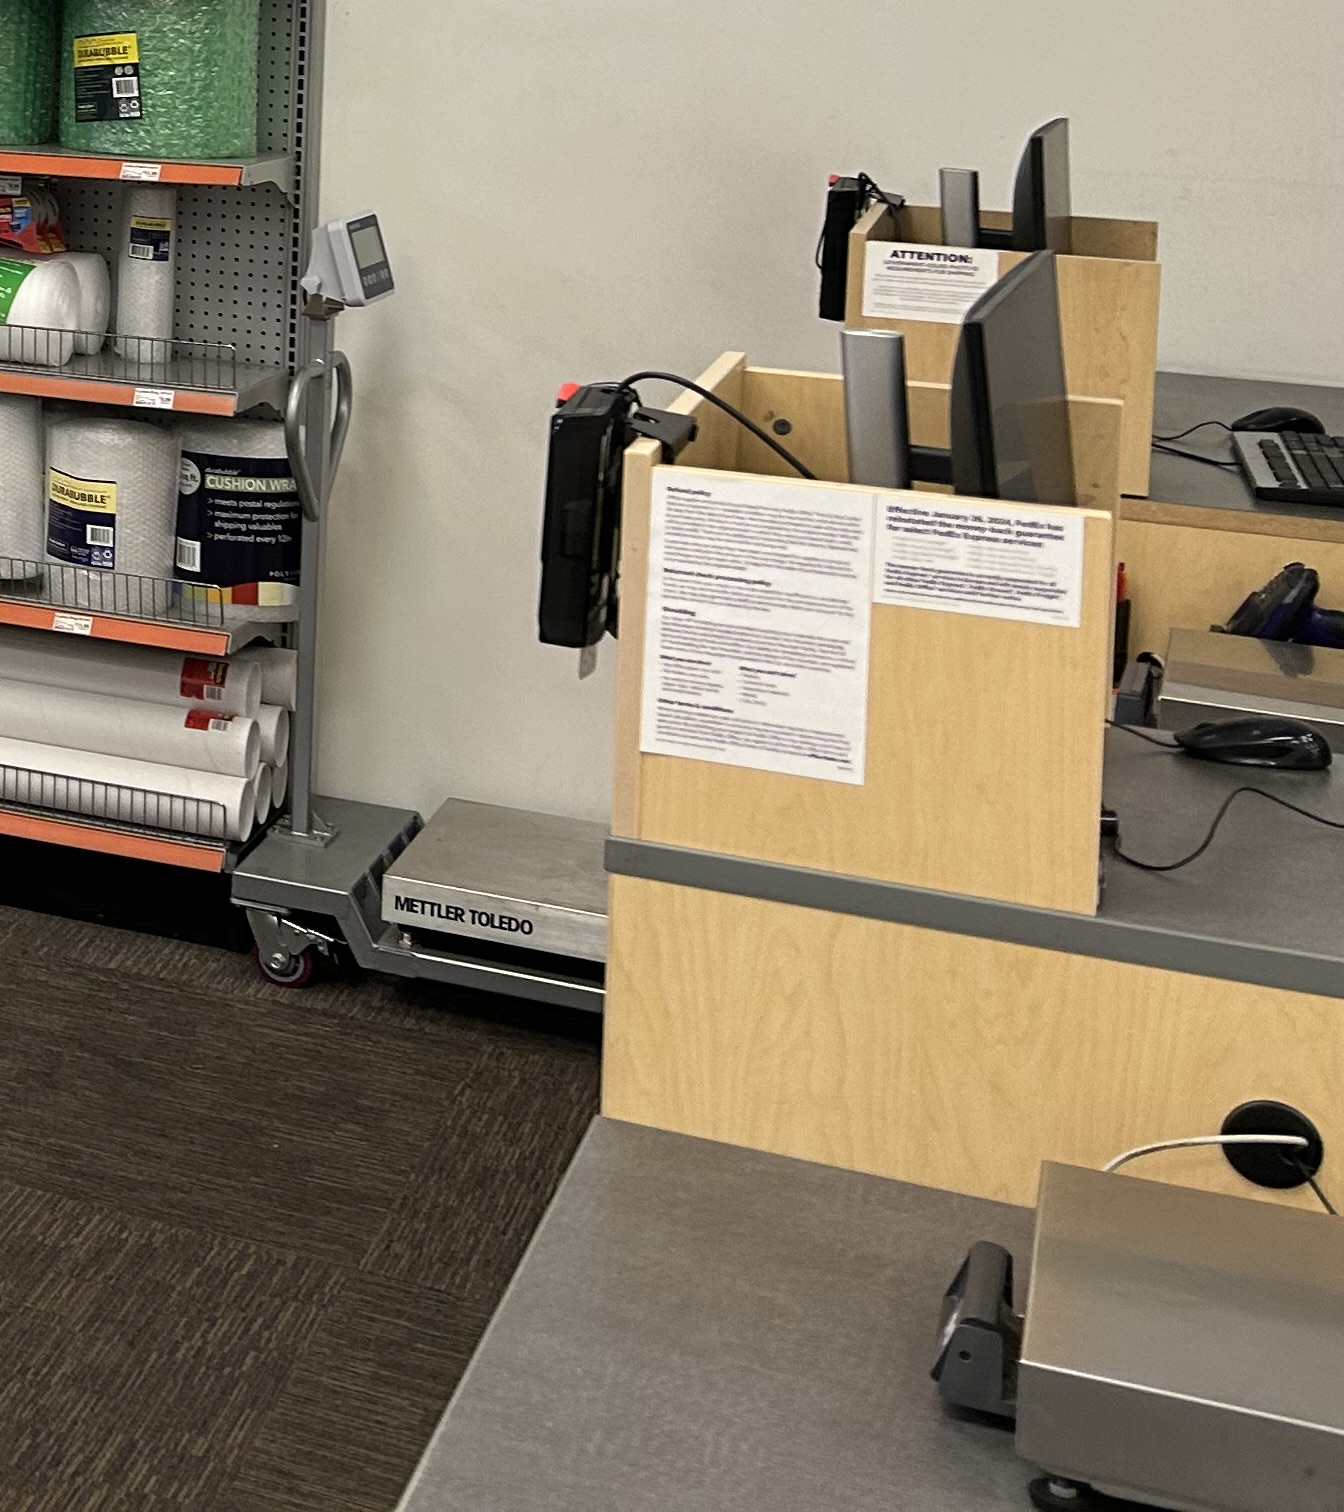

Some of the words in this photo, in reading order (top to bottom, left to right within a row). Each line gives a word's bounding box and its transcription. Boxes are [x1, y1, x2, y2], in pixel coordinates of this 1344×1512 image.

[890, 250, 973, 264] ATTENTION:
[206, 476, 266, 491] CUSHION
[214, 499, 238, 507] meets
[239, 500, 262, 508] postal
[394, 895, 465, 923] METTLER
[469, 909, 534, 935] TOLEDO
